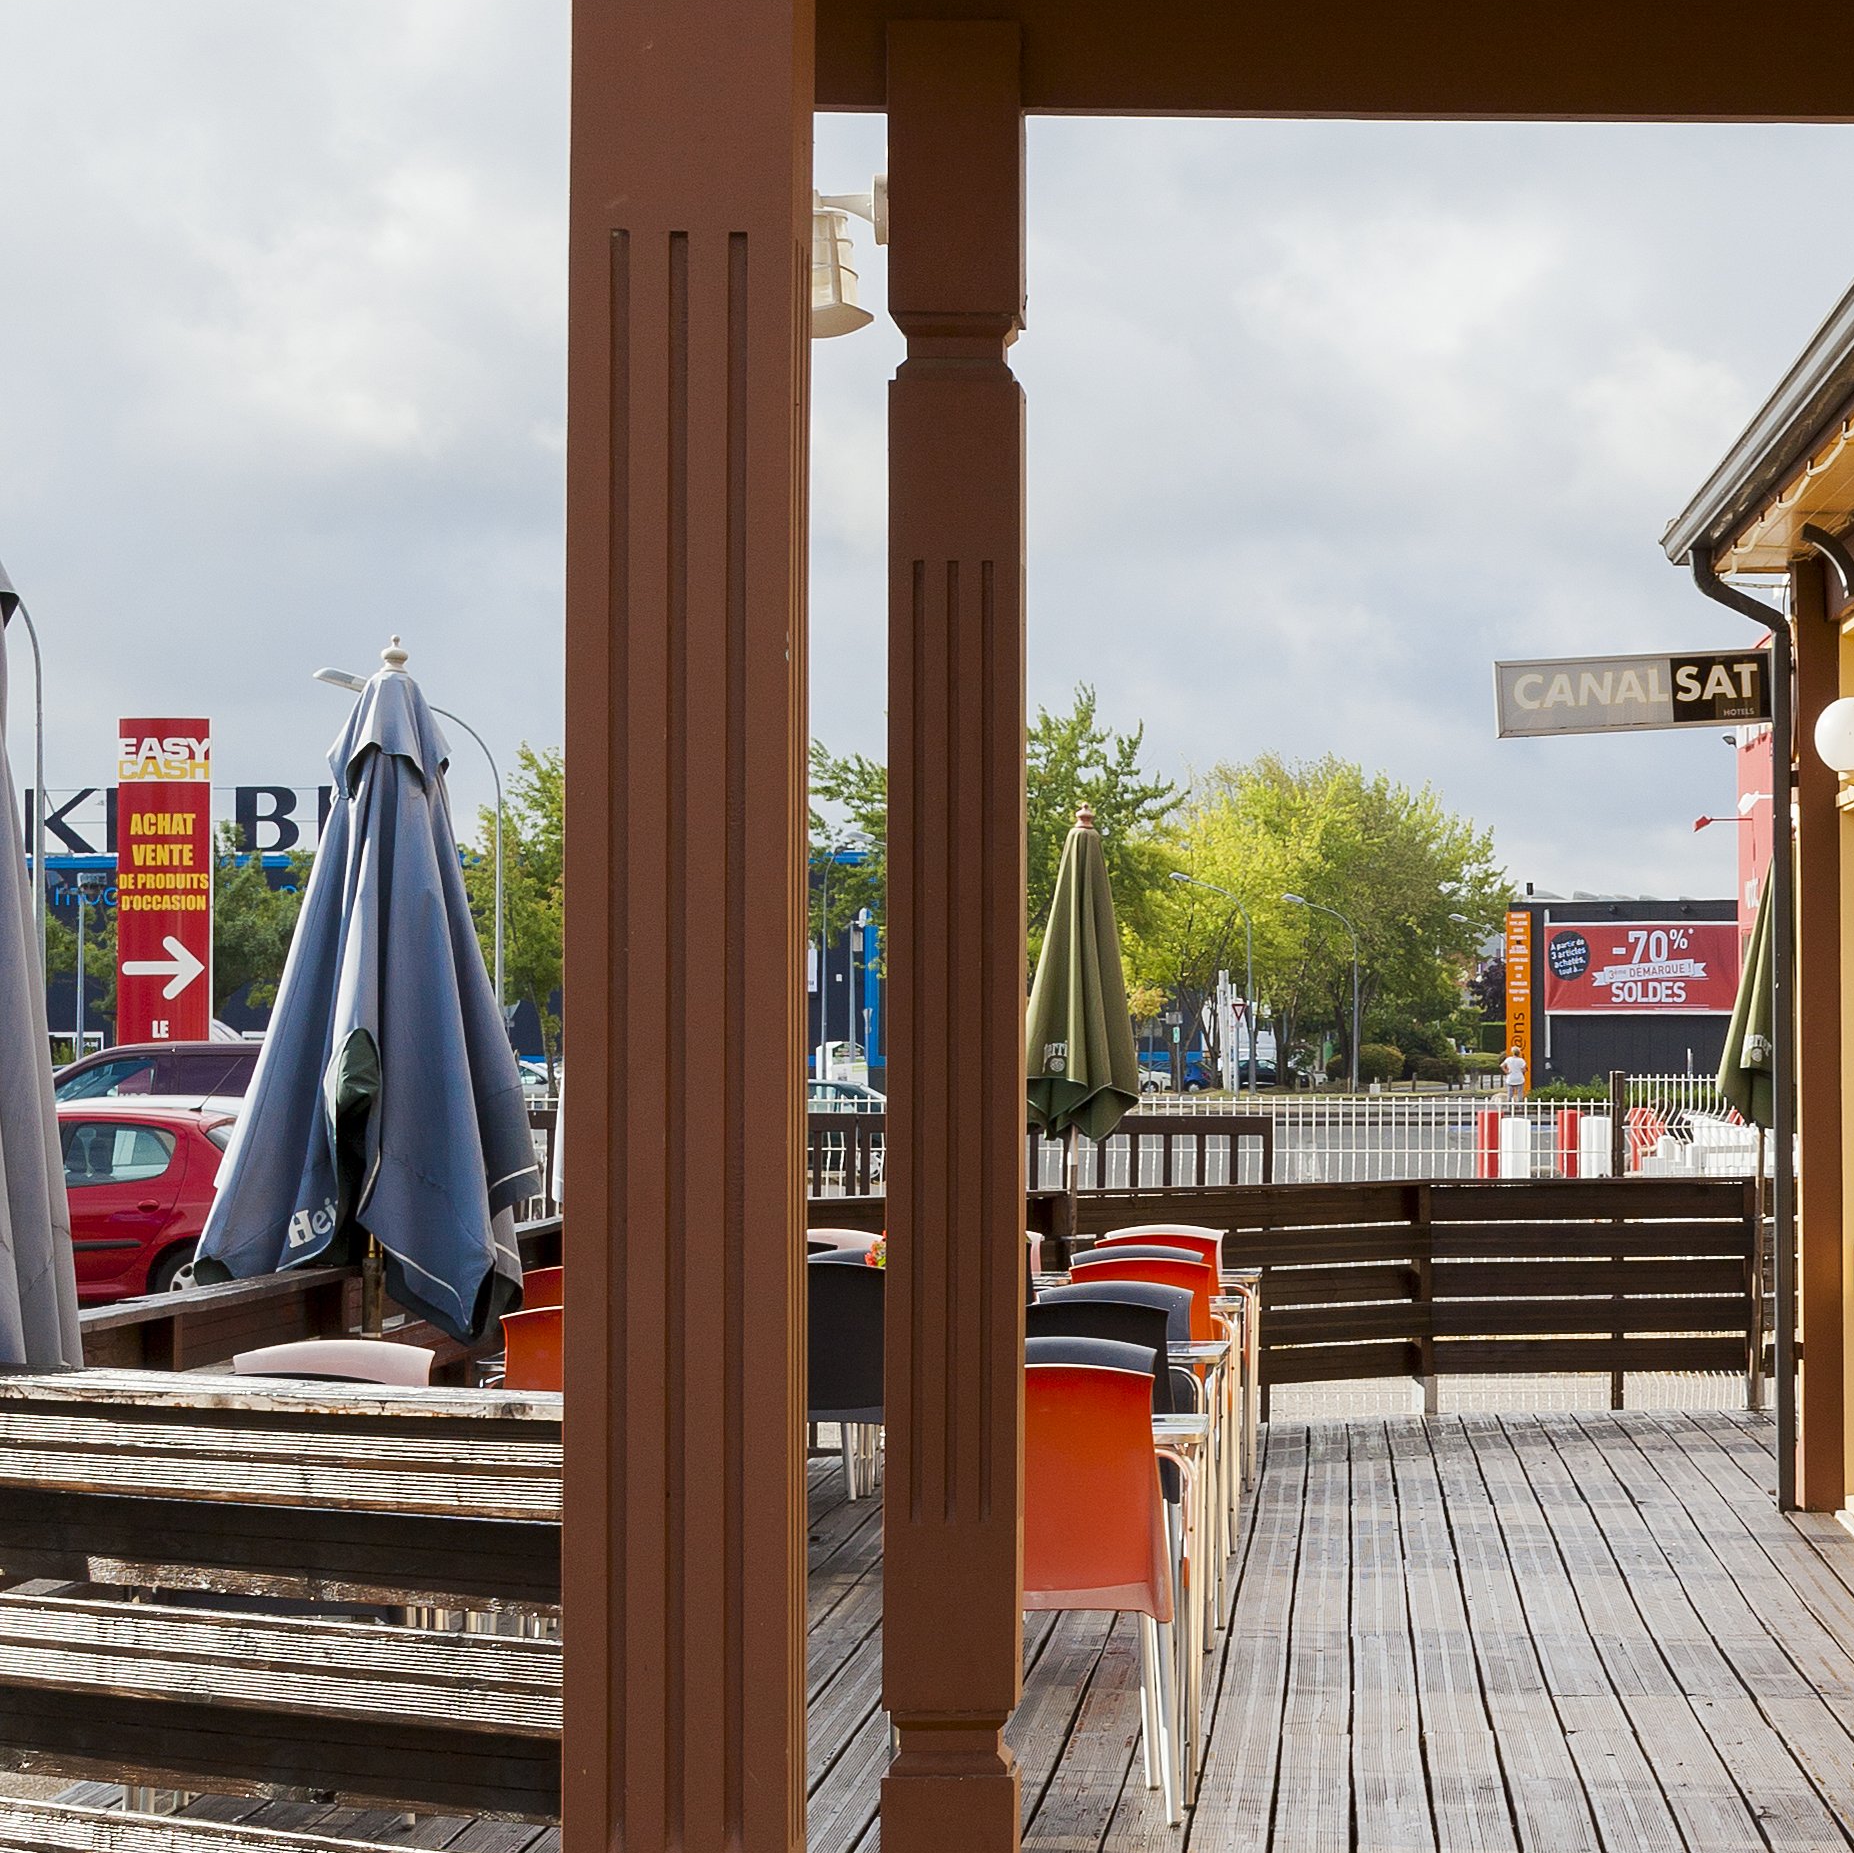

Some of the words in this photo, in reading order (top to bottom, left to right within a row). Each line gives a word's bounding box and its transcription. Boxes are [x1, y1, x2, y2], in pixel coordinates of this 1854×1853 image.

[1723, 707, 1755, 717] HOTELS
[119, 737, 209, 760] EASY
[119, 759, 209, 780] CASH
[130, 813, 196, 835] ACHAT
[132, 844, 194, 867] VENTE
[119, 873, 135, 889] DE
[136, 873, 209, 889] PRODUITS
[121, 894, 207, 911] D'OCCASION
[1629, 965, 1686, 978] DÉMARQUE
[1611, 981, 1687, 1003] SOLDES
[152, 1020, 169, 1038] LE
